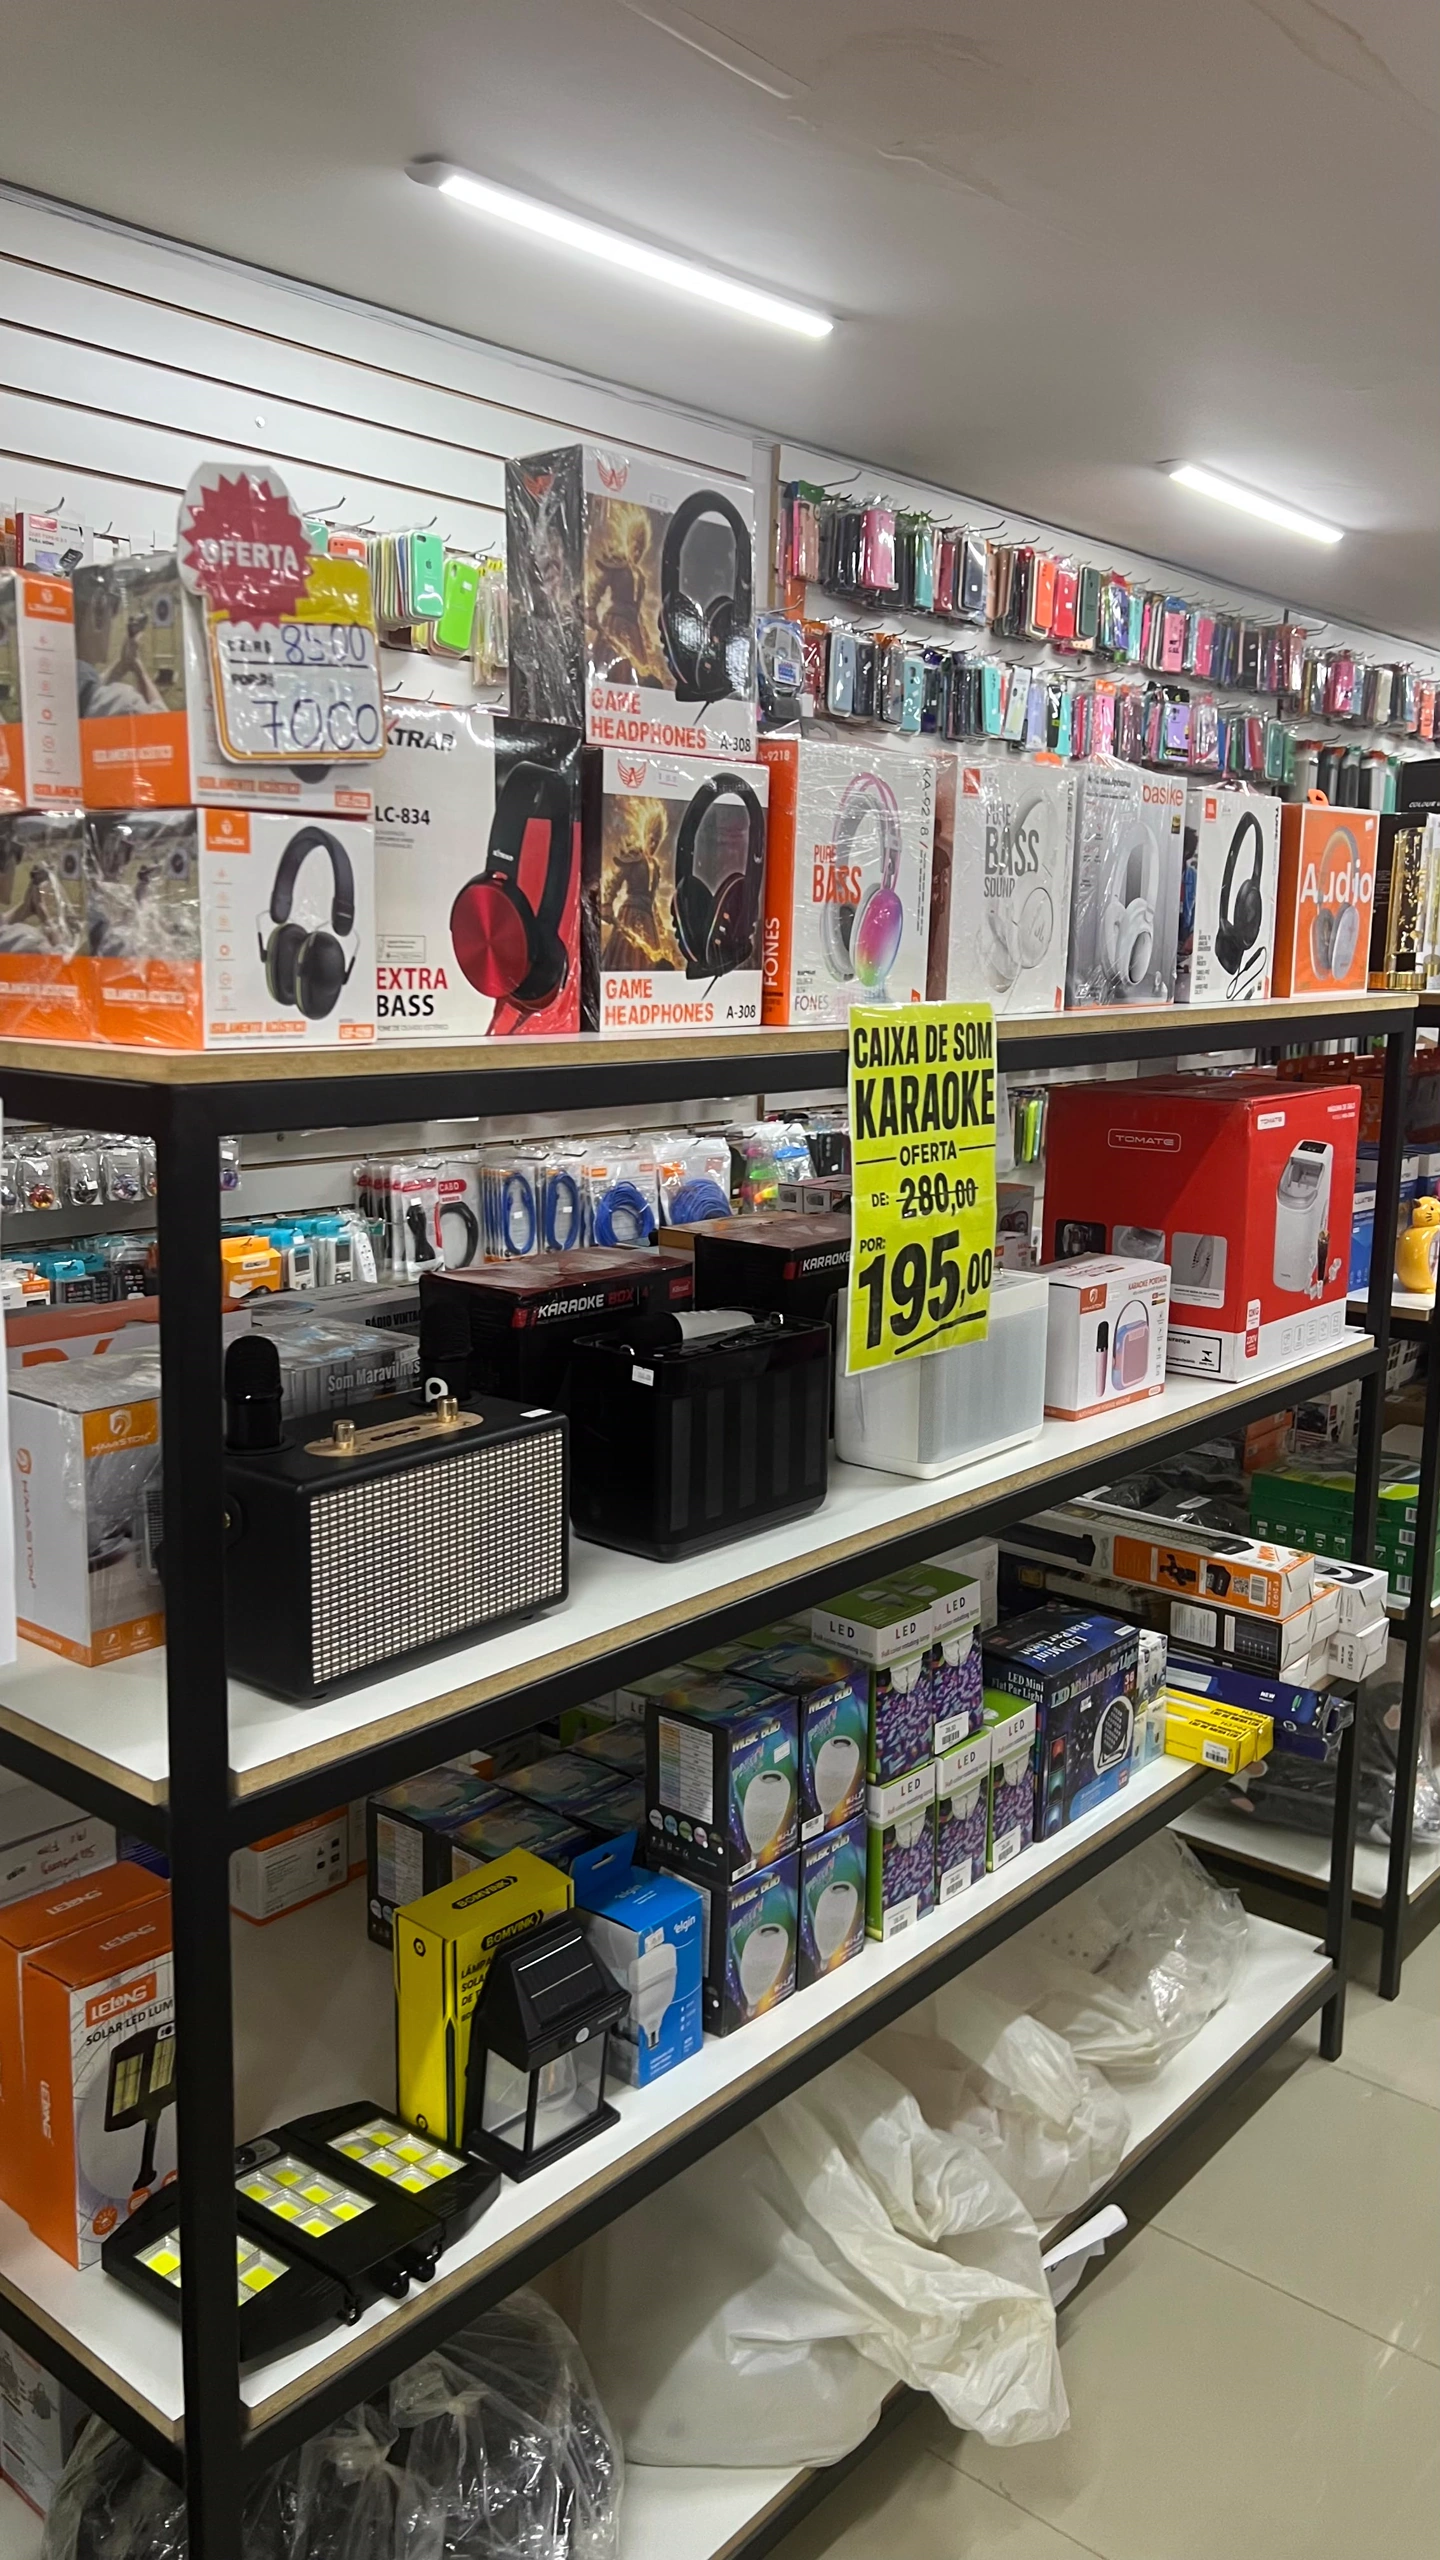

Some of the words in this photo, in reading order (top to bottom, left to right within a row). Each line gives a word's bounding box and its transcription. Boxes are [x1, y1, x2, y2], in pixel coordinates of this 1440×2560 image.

[201, 538, 300, 571] OFERTA
[591, 687, 641, 715] GAME
[591, 715, 707, 750] HEADPHONES
[720, 737, 751, 752] A-308
[374, 806, 430, 825] LC-834
[814, 844, 836, 863] PURE
[985, 826, 1040, 876] BASS
[813, 865, 862, 904] BASS
[1300, 859, 1373, 904] Audio
[763, 917, 780, 986] FONES
[376, 967, 448, 990] EXTRA
[605, 977, 652, 999] GAME
[377, 994, 434, 1017] BASS
[794, 995, 829, 1011] FONES
[604, 1003, 714, 1026] HEADPHONES
[726, 1005, 756, 1018] A-308
[853, 1025, 919, 1069] CAIXA
[925, 1023, 948, 1062] DE
[953, 1021, 992, 1061] SOM
[855, 1069, 995, 1140] KARAOKE
[1115, 1135, 1175, 1146] TOMATE
[899, 1140, 957, 1167] OFERTA
[871, 1193, 889, 1208] DE:
[900, 1172, 977, 1219] 280,00
[859, 1236, 886, 1253] POR:
[803, 1250, 851, 1271] KARAOKE
[858, 1229, 992, 1350] 195,00
[538, 1294, 605, 1318] KARAOKE
[608, 1288, 634, 1305] BOX
[1168, 1336, 1191, 1345] urança
[328, 1375, 354, 1392] Som
[946, 1597, 965, 1614] LED
[829, 1620, 855, 1638] LED
[895, 1622, 916, 1639] LED
[1063, 1635, 1088, 1650] LED
[1008, 1672, 1025, 1686] LED
[1026, 1677, 1044, 1691] Mini
[1051, 1687, 1070, 1709] LED
[1119, 1648, 1139, 1672] Light
[1008, 1681, 1022, 1695] Par
[1023, 1687, 1043, 1704] Light
[631, 1703, 646, 1715] LE
[808, 1695, 833, 1714] MUSIC
[1009, 1719, 1025, 1736] LED
[731, 1732, 759, 1753] MUSIC
[957, 1752, 976, 1769] LED
[901, 1778, 921, 1796] LED
[806, 1847, 831, 1867] MUSIC
[46, 1889, 103, 1915] LELONG
[457, 1878, 510, 1908] BOMVINK
[731, 1888, 759, 1910] MUSIC
[486, 1913, 537, 1948] BOMVINK
[673, 1915, 696, 1935] elgin
[99, 1924, 157, 1951] LELONG
[461, 1972, 486, 1992] SOLA
[91, 1984, 148, 2021] LELONG
[461, 1992, 473, 2007] DE
[86, 2022, 123, 2046] SOLAR
[125, 2011, 146, 2028] LED
[148, 1998, 174, 2017] LUM
